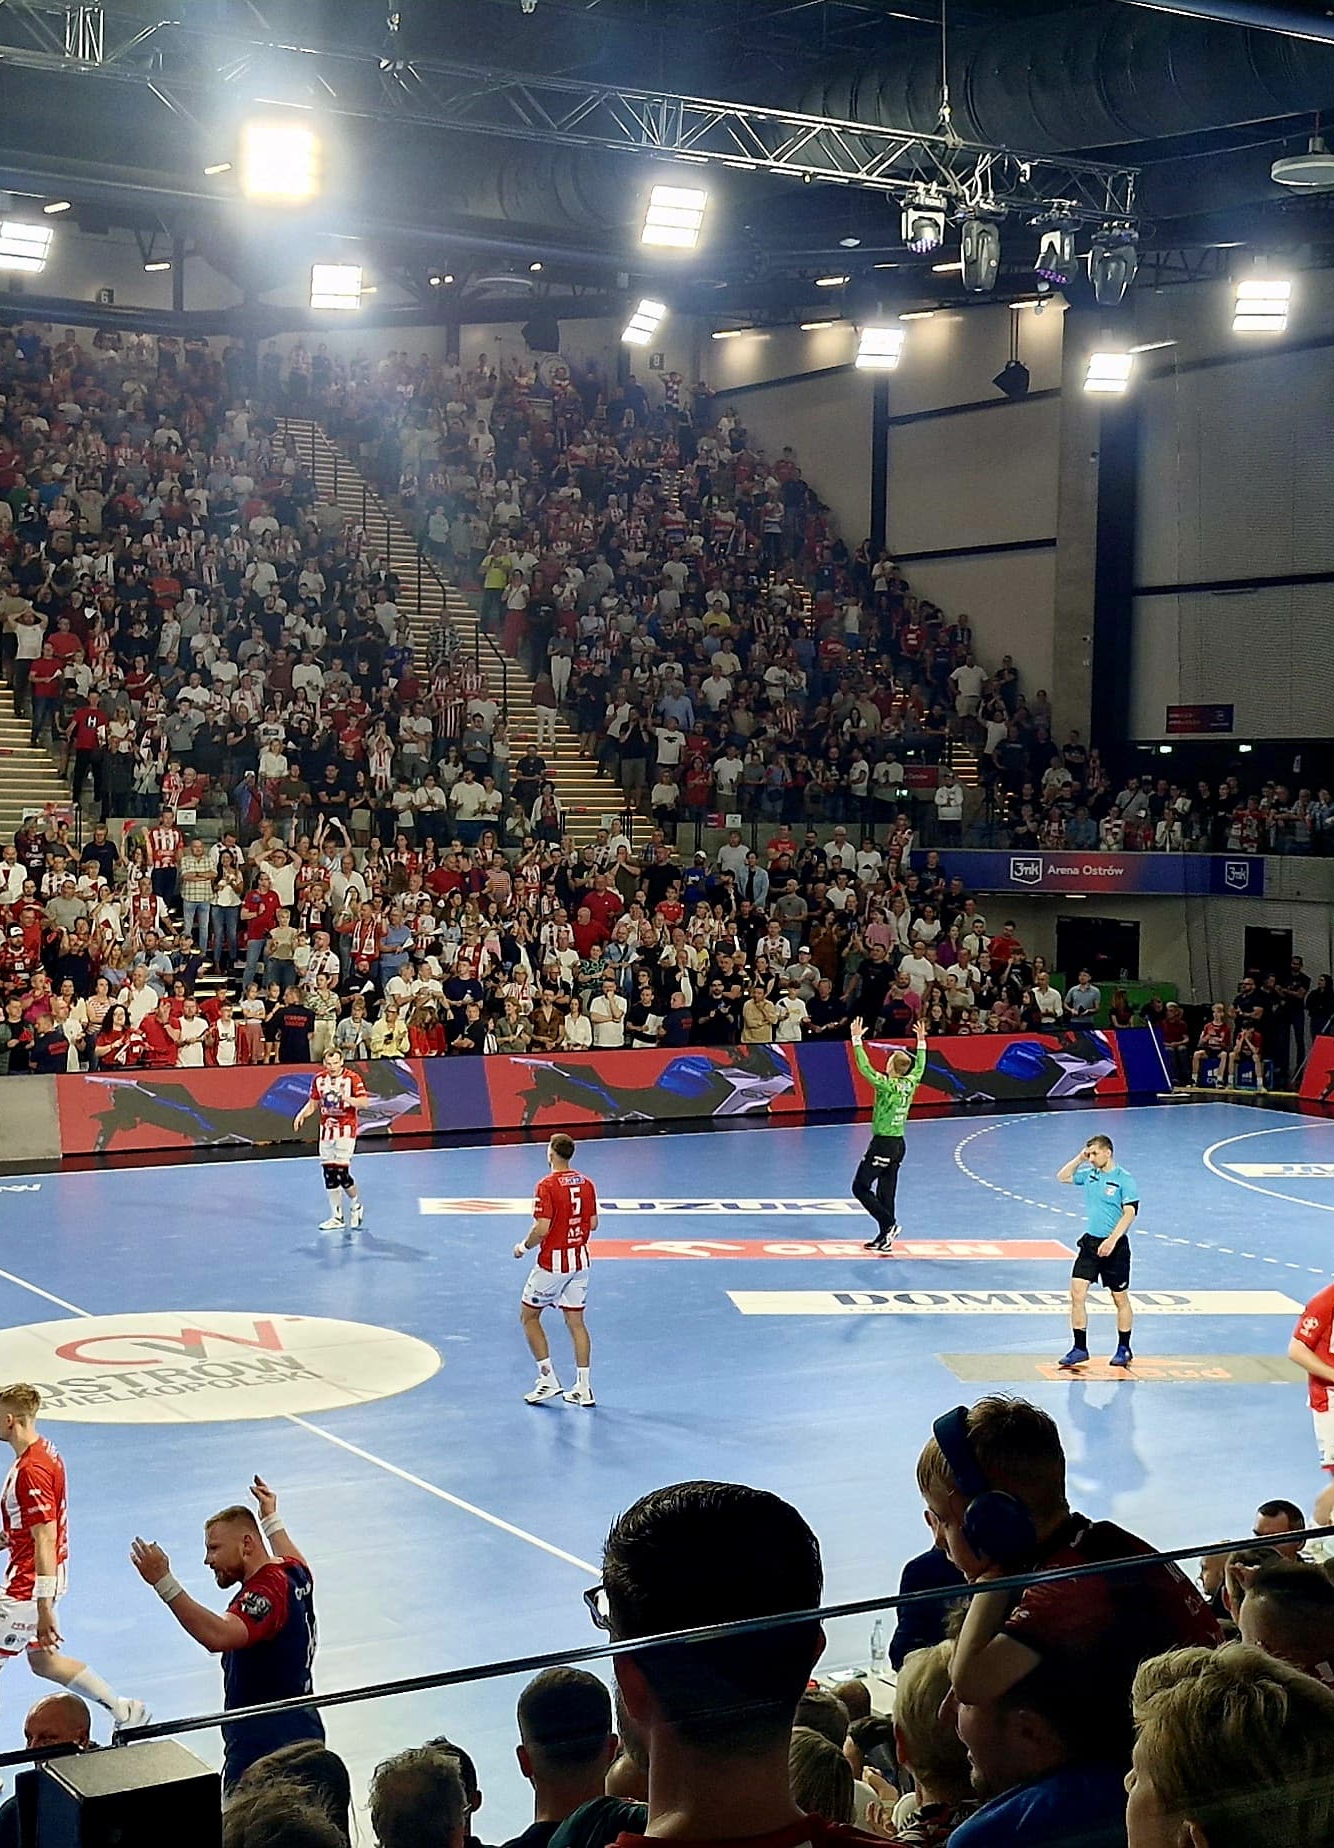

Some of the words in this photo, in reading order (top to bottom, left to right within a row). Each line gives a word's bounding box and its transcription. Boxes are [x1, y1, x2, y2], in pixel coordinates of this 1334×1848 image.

[1014, 862, 1040, 878] 3mk
[1047, 864, 1078, 876] Arena
[1082, 863, 1124, 877] Ostrów
[569, 1186, 582, 1216] 5
[31, 1354, 306, 1400] OSTRÓW
[38, 1369, 323, 1411] WIELKOPOLSKI
